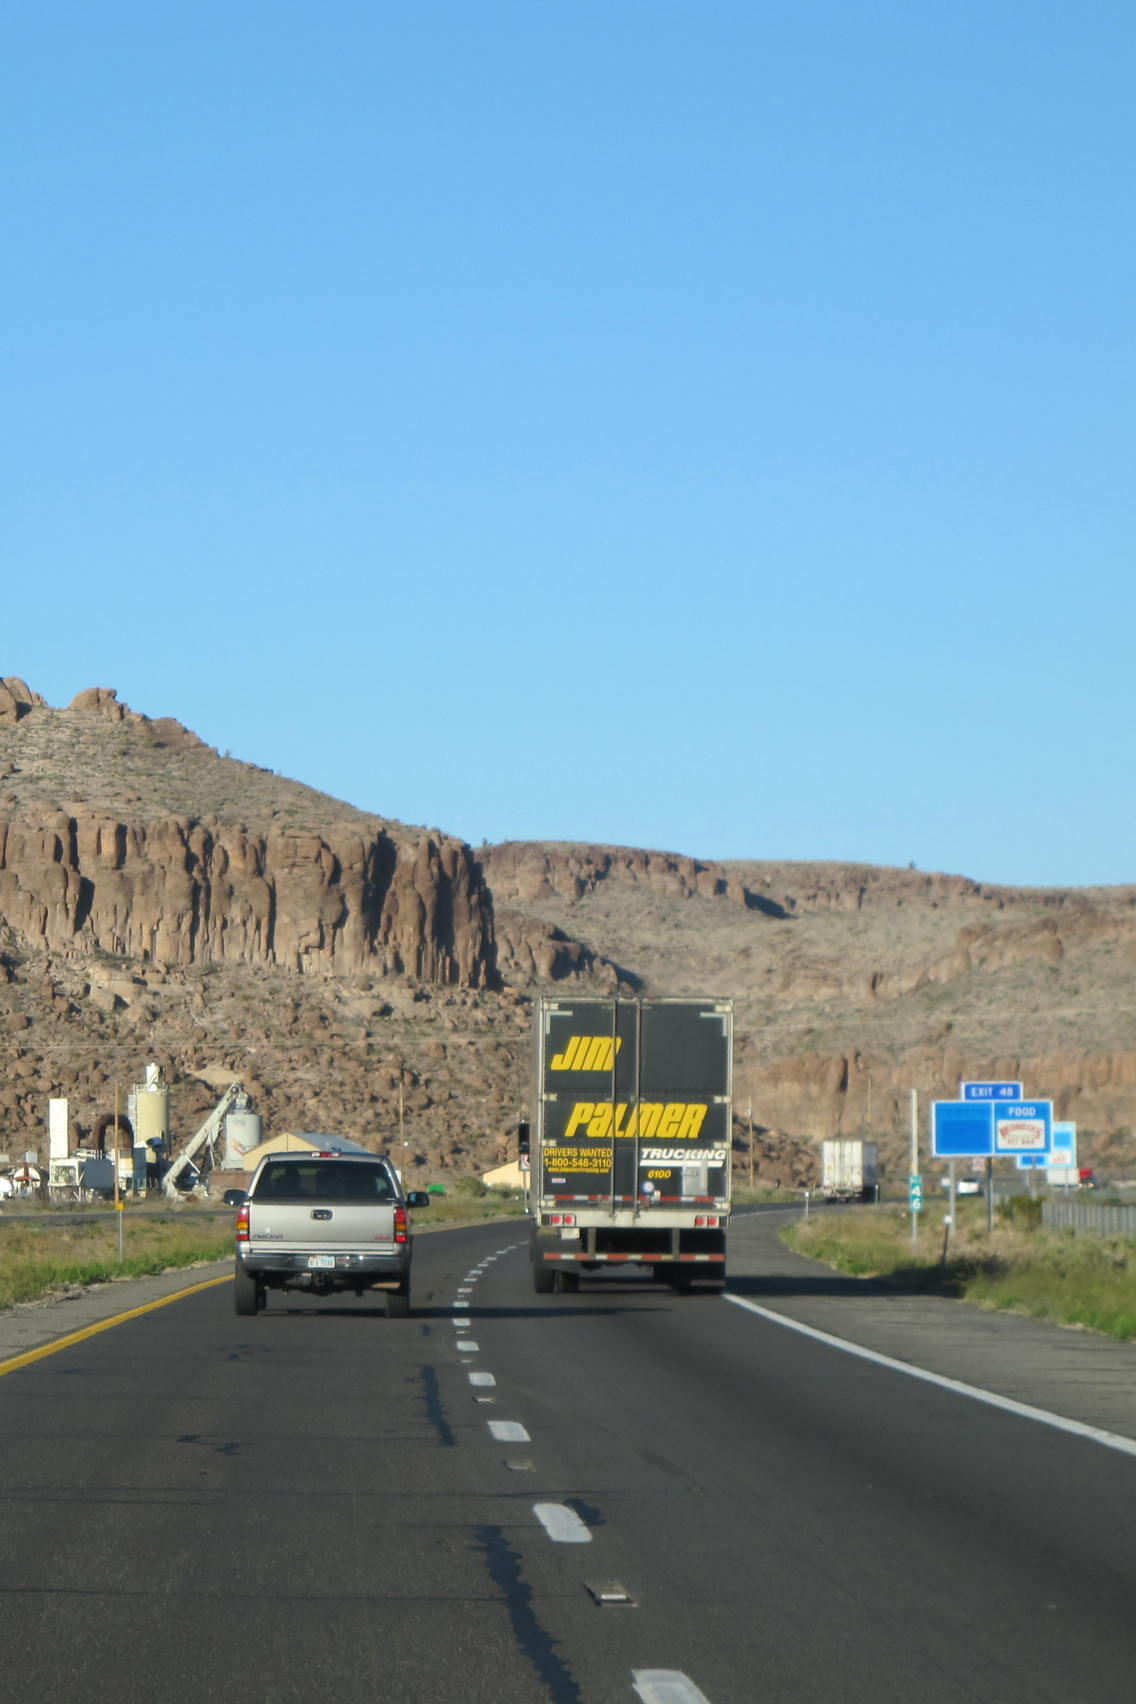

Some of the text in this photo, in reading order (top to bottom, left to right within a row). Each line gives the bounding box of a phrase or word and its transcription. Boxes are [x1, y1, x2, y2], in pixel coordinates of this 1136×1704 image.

[550, 1036, 622, 1071] JIM
[971, 1087, 993, 1097] EXIT
[1008, 1106, 1036, 1117] FOOD
[544, 1147, 613, 1158] DRIVERS WANTED
[641, 1148, 727, 1160] TRUCKING
[544, 1157, 612, 1168] 1-800-548-3110
[648, 1169, 672, 1179] 6100
